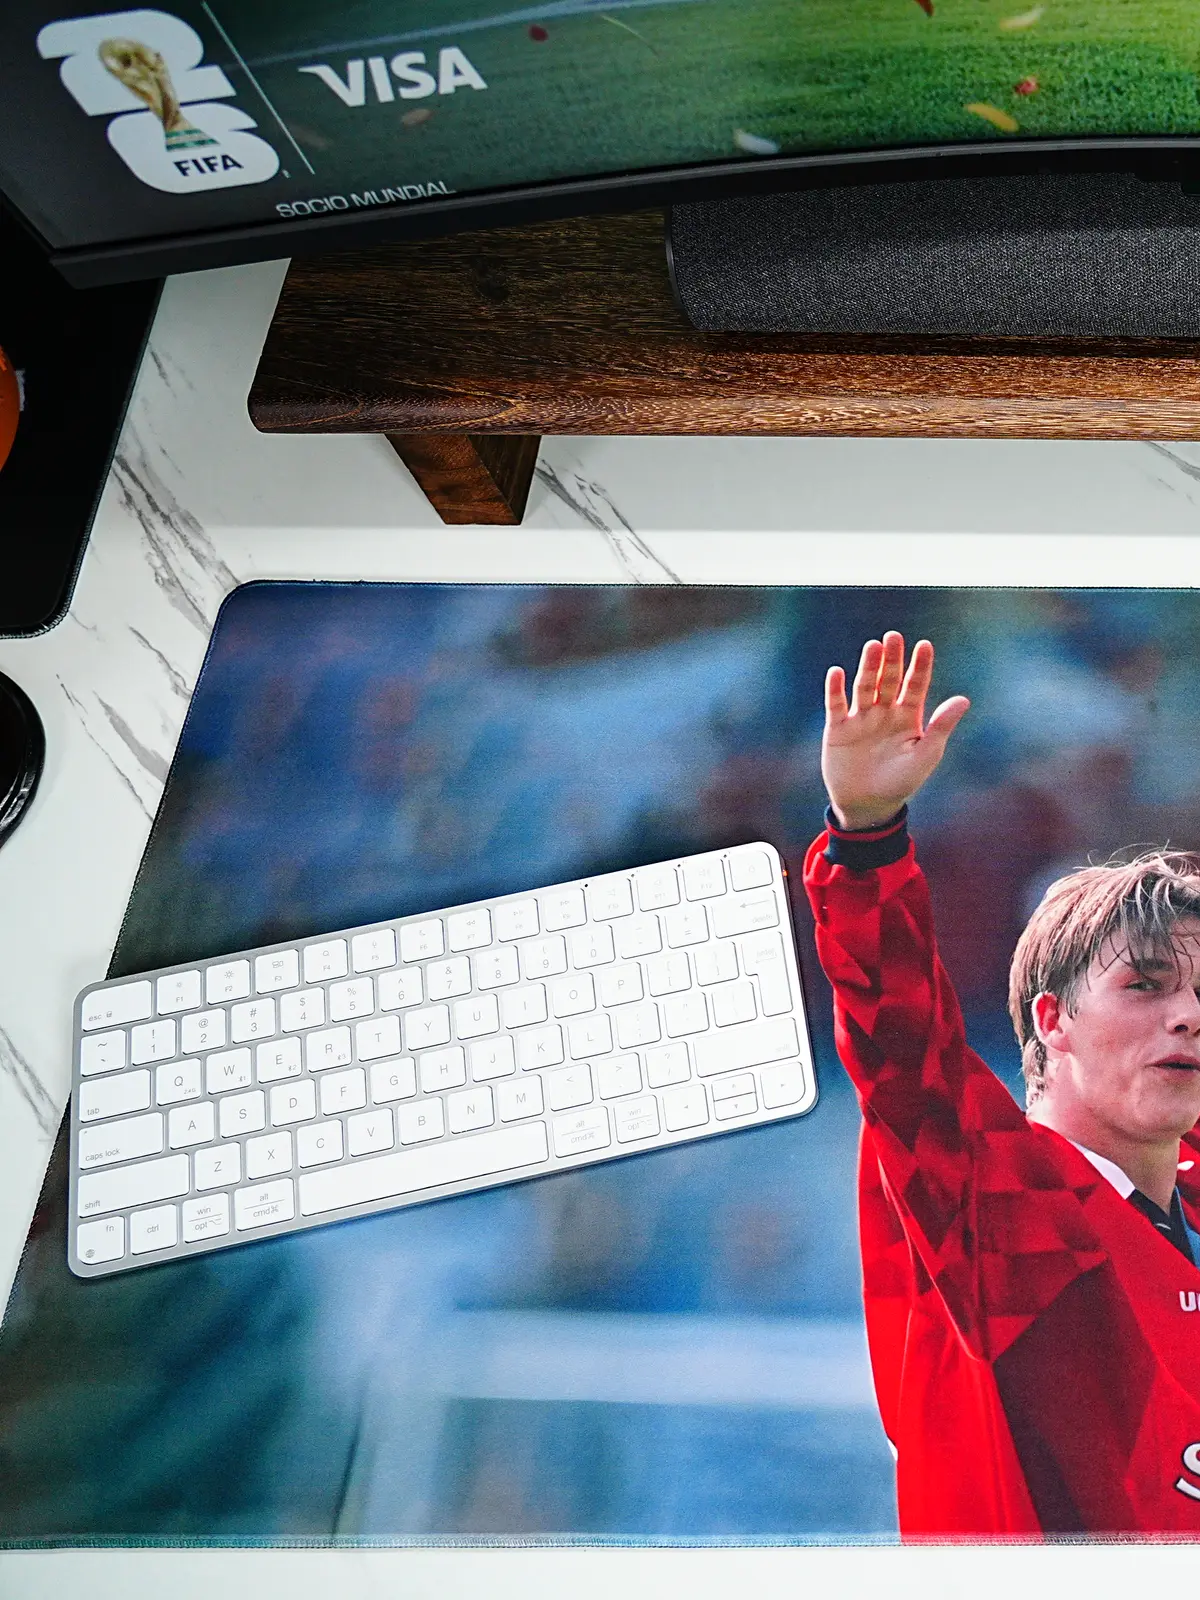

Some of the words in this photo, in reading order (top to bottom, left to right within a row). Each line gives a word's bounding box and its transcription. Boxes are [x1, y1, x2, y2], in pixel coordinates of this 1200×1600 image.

[298, 46, 488, 107] VISA
[174, 154, 243, 177] FIFA
[276, 195, 349, 218] SOCIO
[350, 180, 457, 208] MUNDIAL
[322, 964, 331, 972] F4
[542, 958, 550, 969] 9
[444, 966, 453, 975] &
[494, 969, 502, 980] 8
[274, 975, 283, 983] F3
[446, 979, 453, 990] 7
[617, 979, 625, 990] P
[224, 985, 234, 993] F2
[346, 987, 357, 996] %
[175, 995, 184, 1003] F1
[397, 990, 405, 1001] 6
[568, 989, 579, 1001] O
[299, 996, 306, 1007] $
[349, 1000, 357, 1011] 5
[88, 1014, 102, 1022] esc
[249, 1007, 257, 1018] #
[299, 1011, 307, 1021] 4
[472, 1010, 482, 1022] U
[197, 1017, 209, 1029] @
[250, 1021, 258, 1033] 3
[423, 1021, 432, 1032] Y
[200, 1032, 208, 1044] 2
[374, 1032, 382, 1043] T
[586, 1032, 595, 1042] L
[150, 1043, 156, 1054] 1
[324, 1043, 334, 1055] R
[536, 1042, 546, 1053] K
[275, 1053, 284, 1066] E
[489, 1053, 496, 1064] J
[223, 1064, 236, 1077] W
[439, 1063, 449, 1075] H
[173, 1075, 184, 1087] Q
[389, 1074, 399, 1087] G
[339, 1085, 348, 1098] F
[289, 1097, 298, 1109] D
[515, 1092, 527, 1104] M
[86, 1107, 100, 1116] tab
[238, 1108, 248, 1120] S
[466, 1103, 476, 1115] N
[627, 1108, 642, 1117] win
[187, 1119, 197, 1131] A
[417, 1115, 427, 1127] B
[575, 1120, 586, 1129] alt
[627, 1121, 640, 1131] opt
[366, 1126, 375, 1138] V
[315, 1137, 325, 1149] C
[85, 1152, 104, 1162] caps
[104, 1147, 121, 1157] lock
[267, 1148, 276, 1161] X
[213, 1160, 222, 1173] Z
[259, 1193, 269, 1202] alt
[84, 1199, 101, 1210] shift
[196, 1207, 212, 1217] win
[105, 1224, 115, 1233] fn
[146, 1223, 160, 1234] ctrl
[193, 1218, 209, 1232] opt
